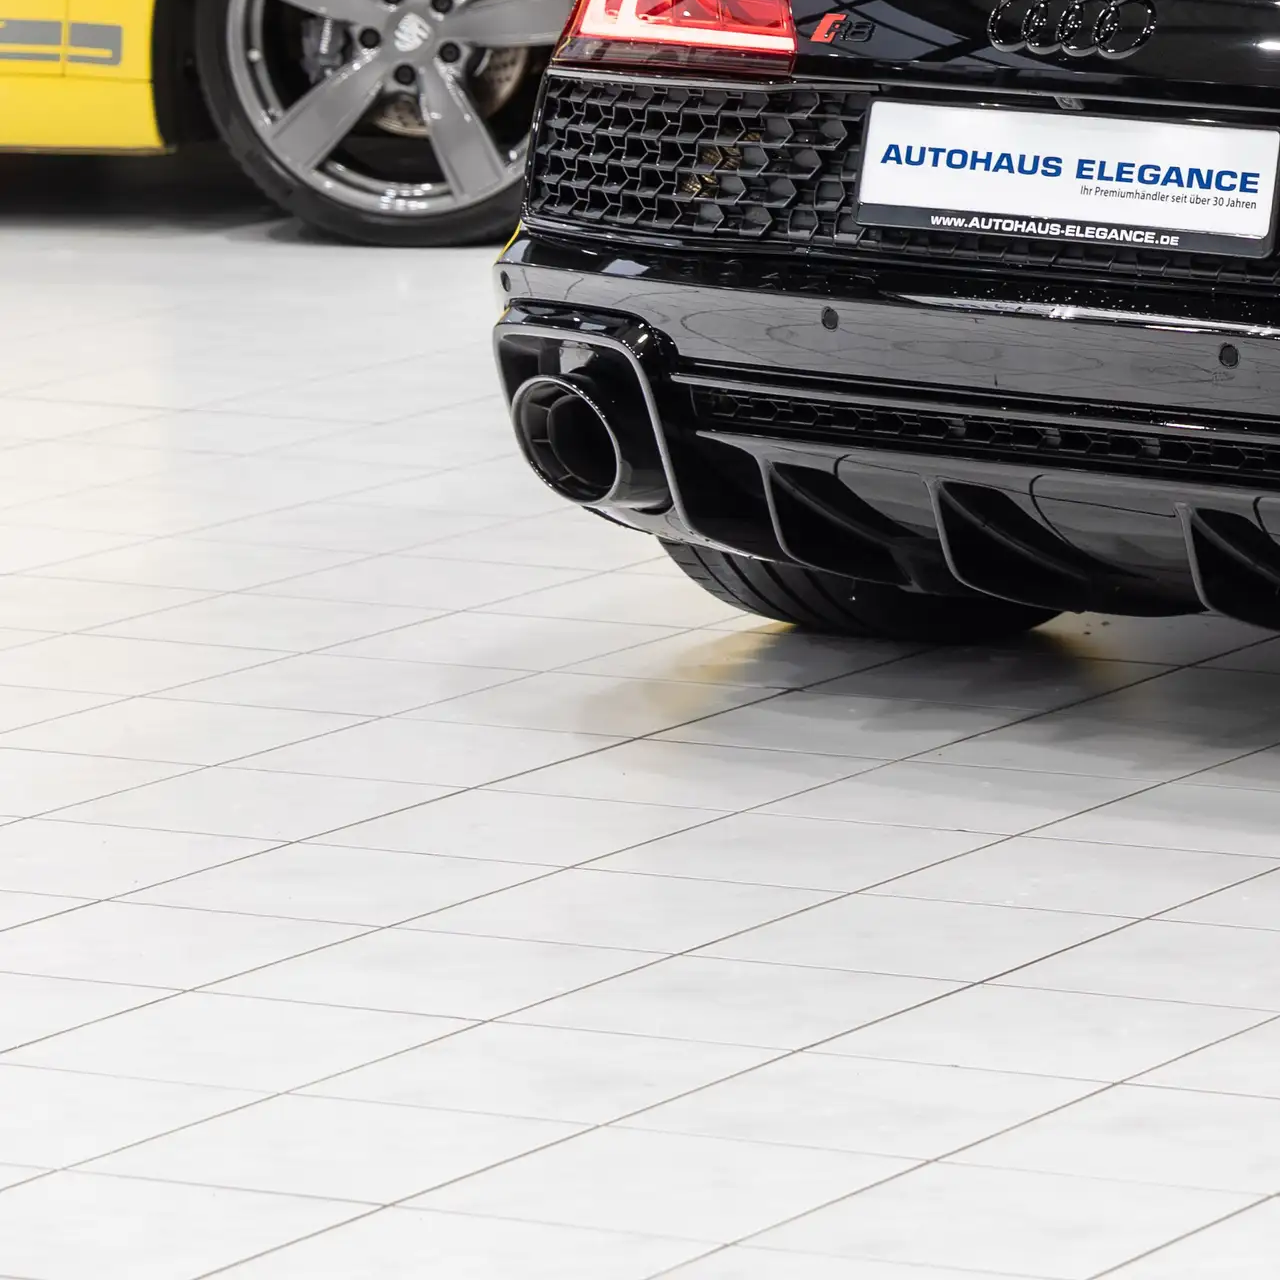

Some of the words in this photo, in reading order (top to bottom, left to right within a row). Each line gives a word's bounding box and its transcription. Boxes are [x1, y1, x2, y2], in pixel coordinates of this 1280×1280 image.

[880, 144, 1063, 178] AUTOHAUS
[1075, 158, 1261, 194] ELEGANCE
[1080, 185, 1094, 196] Ihr
[1095, 186, 1170, 203] Premiumhändler
[1171, 194, 1187, 204] seit
[1189, 194, 1211, 206] über
[1212, 196, 1225, 207] 30
[1225, 197, 1257, 209] Jahren
